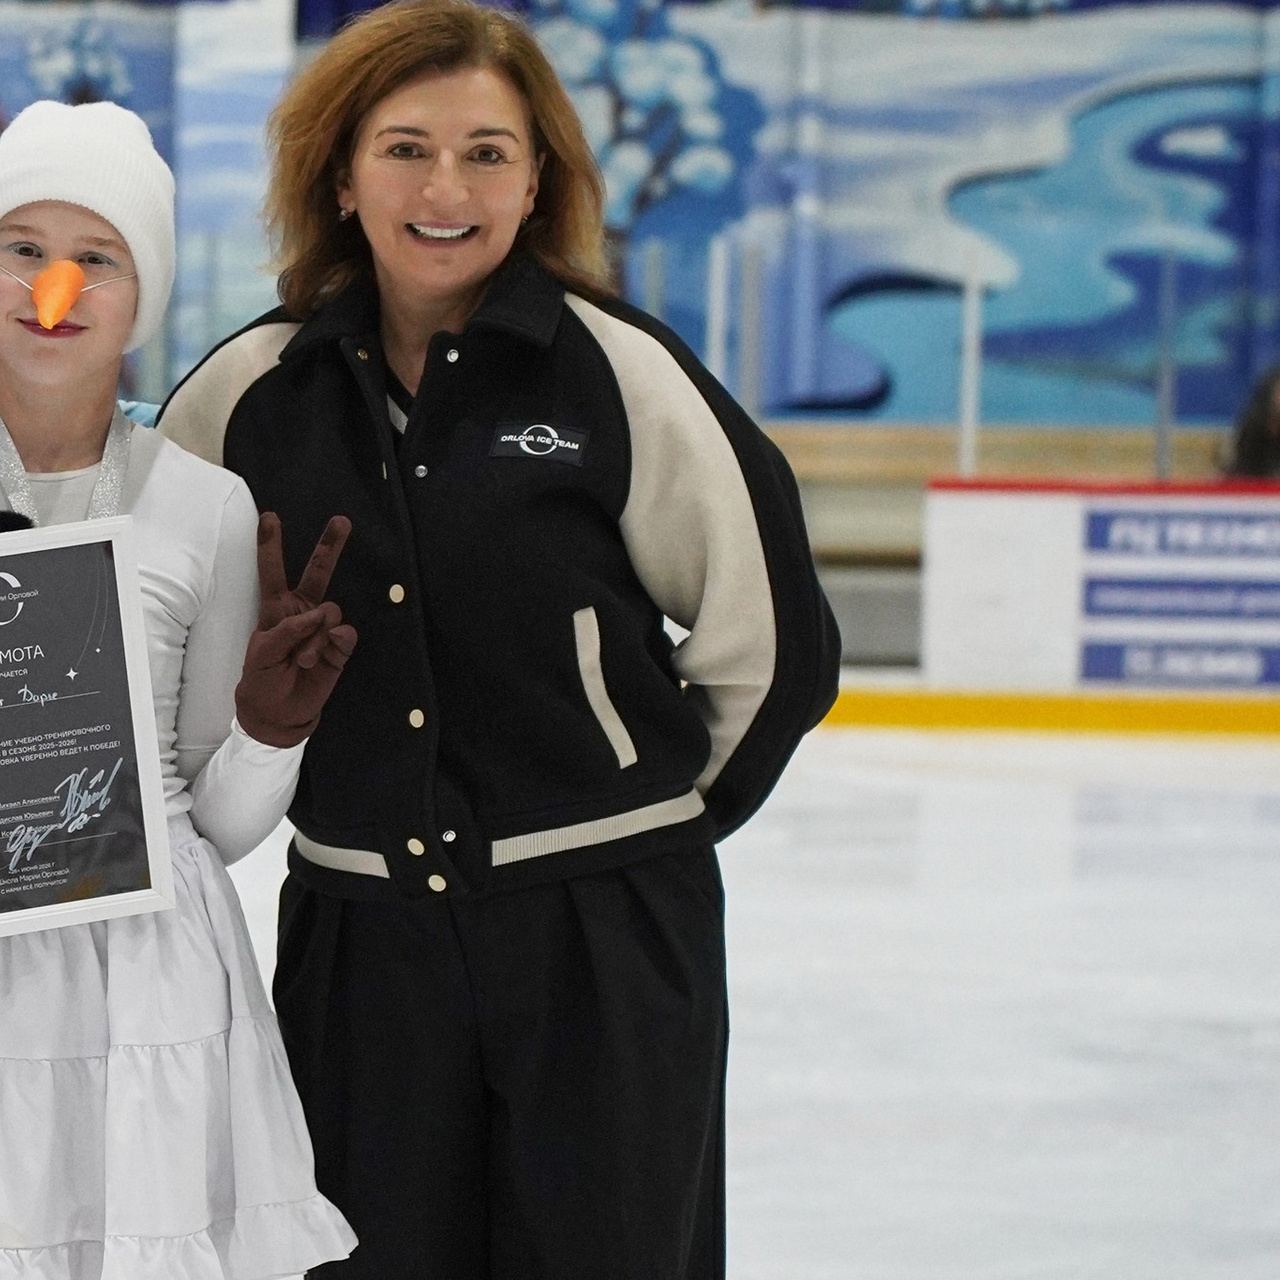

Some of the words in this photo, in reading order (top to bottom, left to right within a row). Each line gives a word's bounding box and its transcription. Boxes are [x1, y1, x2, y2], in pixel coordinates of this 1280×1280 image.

[536, 435, 552, 445] ICE
[553, 439, 579, 450] TEAM
[7, 588, 40, 601] Орловой
[14, 724, 112, 746] УЧЕБНО-ТРЕНИРОВОЧНОГО
[8, 744, 37, 755] СЕЗОНЕ
[20, 750, 59, 763] УВЕРЕННО
[59, 746, 83, 756] ВЕДЕТ
[89, 740, 122, 751] ПОБЕДЕ!
[22, 794, 61, 806] Алексеевич
[23, 809, 54, 820] Юрьевич
[19, 873, 41, 882] Марии
[41, 867, 70, 879] Орловой
